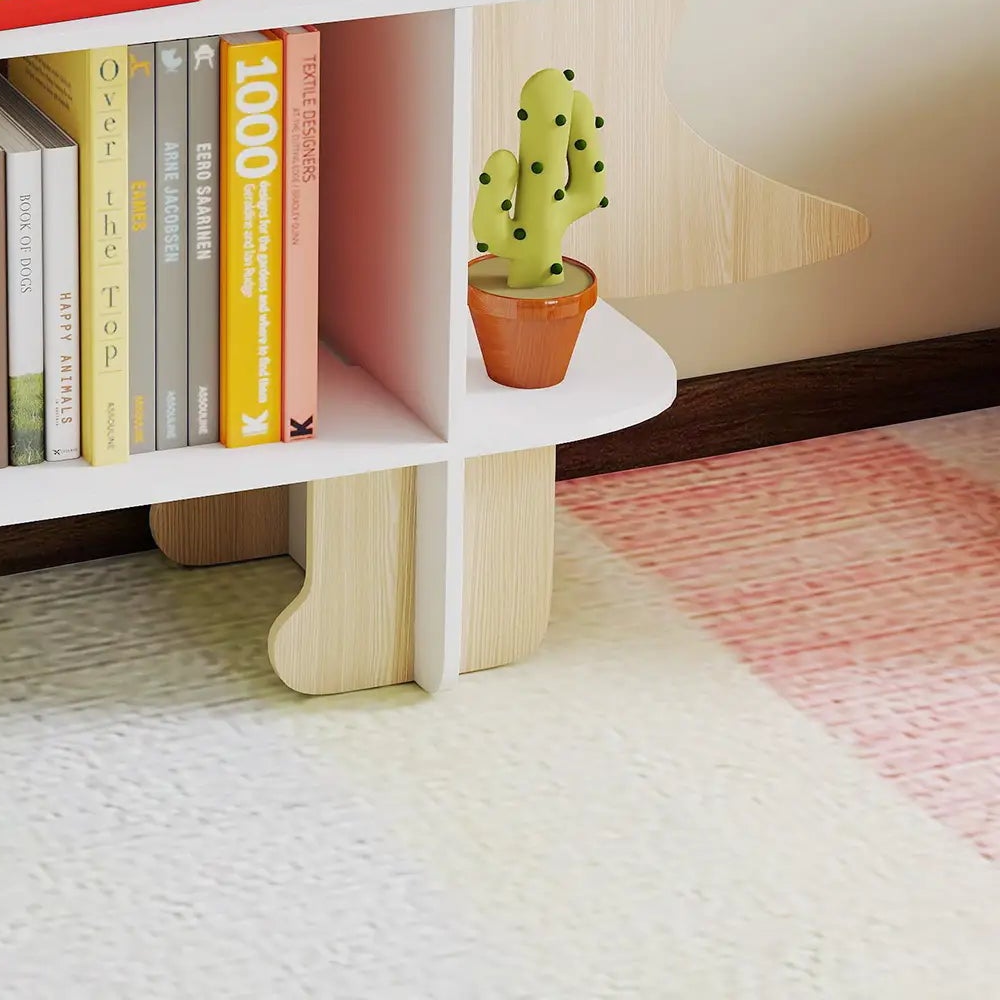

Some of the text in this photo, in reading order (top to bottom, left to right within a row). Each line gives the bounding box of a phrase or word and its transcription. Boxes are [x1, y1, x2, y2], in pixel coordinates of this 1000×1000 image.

[99, 59, 119, 156] Over
[235, 55, 278, 179] 1000
[302, 54, 317, 184] TEXTILE DESIGNERS
[20, 194, 32, 293] BOOK OF DOGS
[104, 191, 118, 259] the
[131, 180, 147, 232] EAMES
[164, 142, 180, 263] ARNE JACOBSEN
[196, 142, 212, 260] EERO SAARINEN
[60, 292, 73, 424] HAPPY ANIMALS
[198, 385, 209, 435] ASSOULINE
